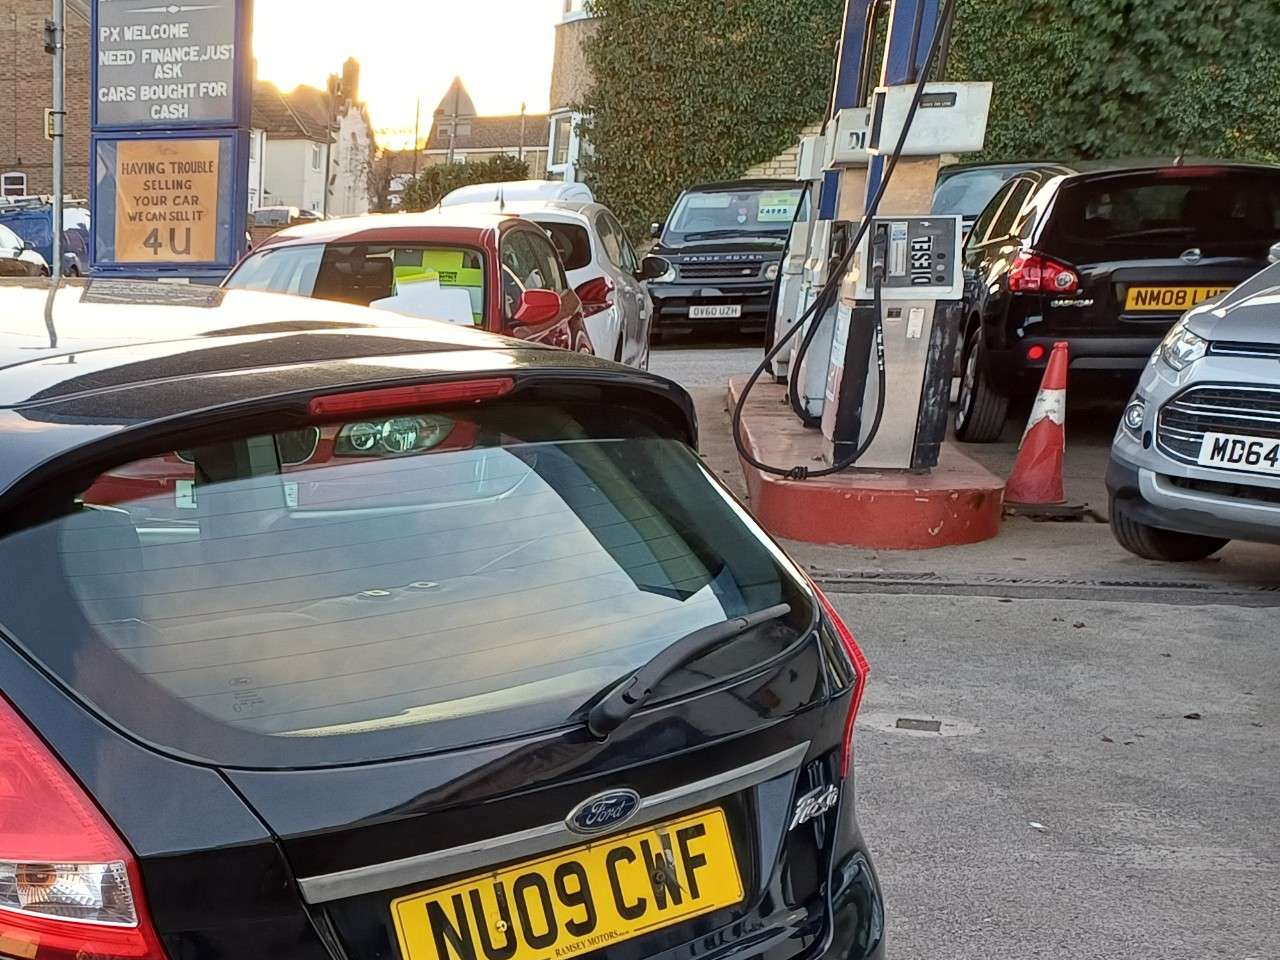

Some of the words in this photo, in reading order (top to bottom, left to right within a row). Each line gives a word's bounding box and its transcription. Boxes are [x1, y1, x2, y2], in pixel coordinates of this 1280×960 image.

[100, 26, 120, 42] PX
[124, 23, 189, 41] WELCOME
[99, 51, 136, 65] NEED
[154, 63, 183, 79] ASK
[98, 87, 136, 102] CARS
[140, 84, 196, 101] BOUGHT
[199, 82, 227, 97] FOR
[151, 104, 189, 119] CASH
[122, 162, 166, 175] HAVING
[169, 160, 214, 174] TROUBLE
[143, 180, 192, 191] SELLING
[133, 196, 167, 207] YOUR
[173, 195, 199, 206] CAR
[128, 211, 144, 222] WE
[145, 211, 166, 222] CAN
[169, 211, 190, 222] SELL
[192, 211, 203, 221] IT
[911, 236, 933, 285] DIESEL
[1135, 290, 1188, 306] NM08
[720, 306, 738, 316] UZH
[1210, 437, 1279, 467] MD64
[586, 797, 626, 825] Ford
[606, 823, 708, 921] CWF
[555, 941, 587, 957] RAMSEY
[587, 930, 619, 946] MOTORS
